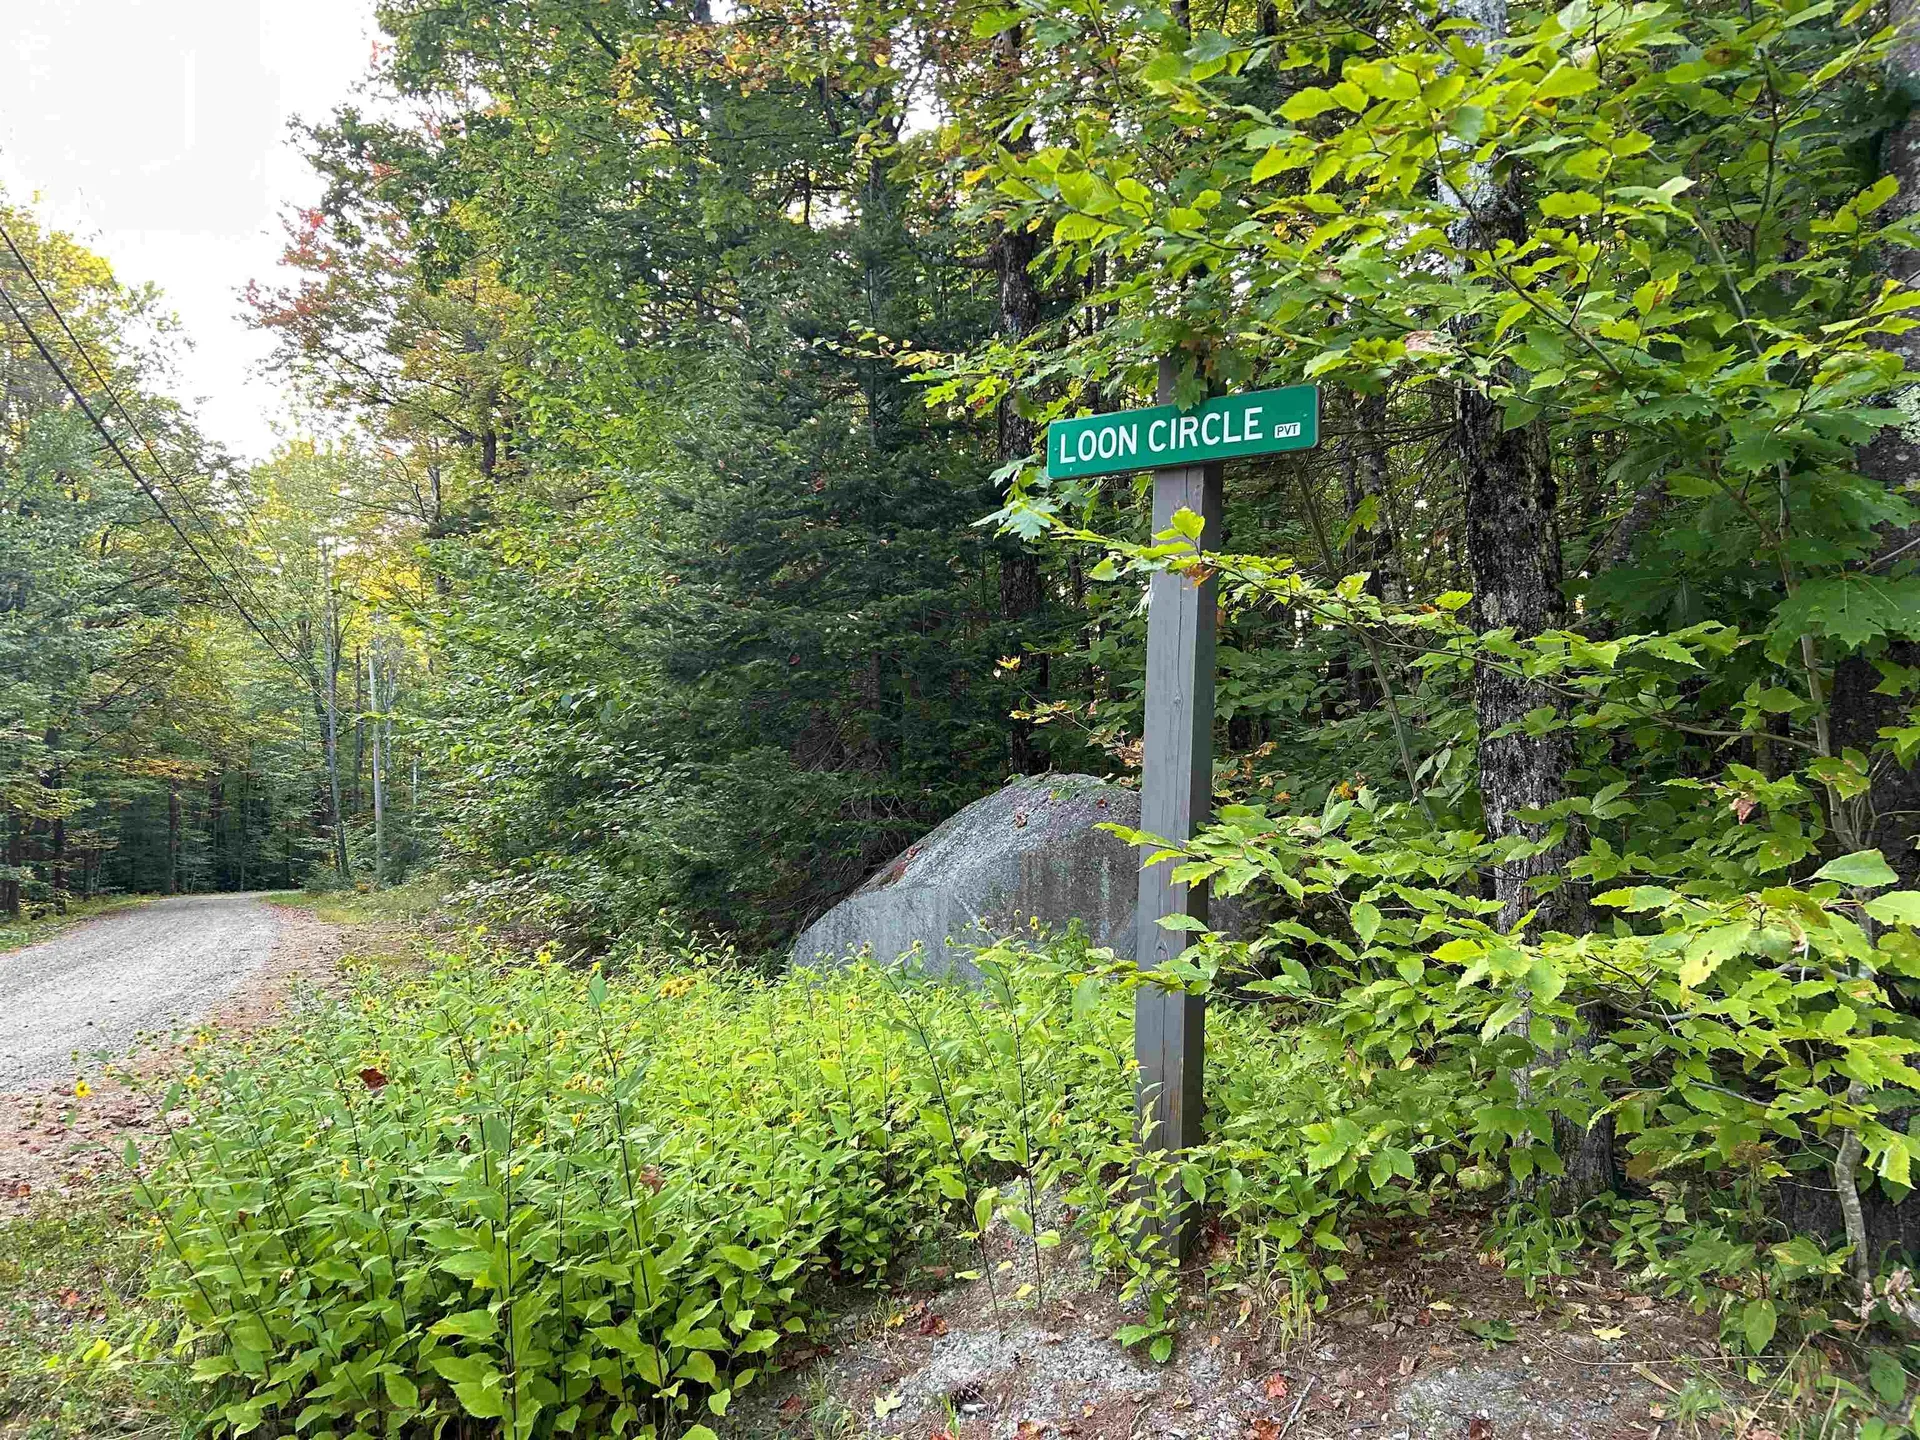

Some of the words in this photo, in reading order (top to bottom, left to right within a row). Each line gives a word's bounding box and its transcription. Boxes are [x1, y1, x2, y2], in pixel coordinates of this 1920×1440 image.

[1059, 423, 1138, 464] LOON
[1148, 406, 1263, 453] CIRCLE
[1276, 423, 1299, 437] PVT
